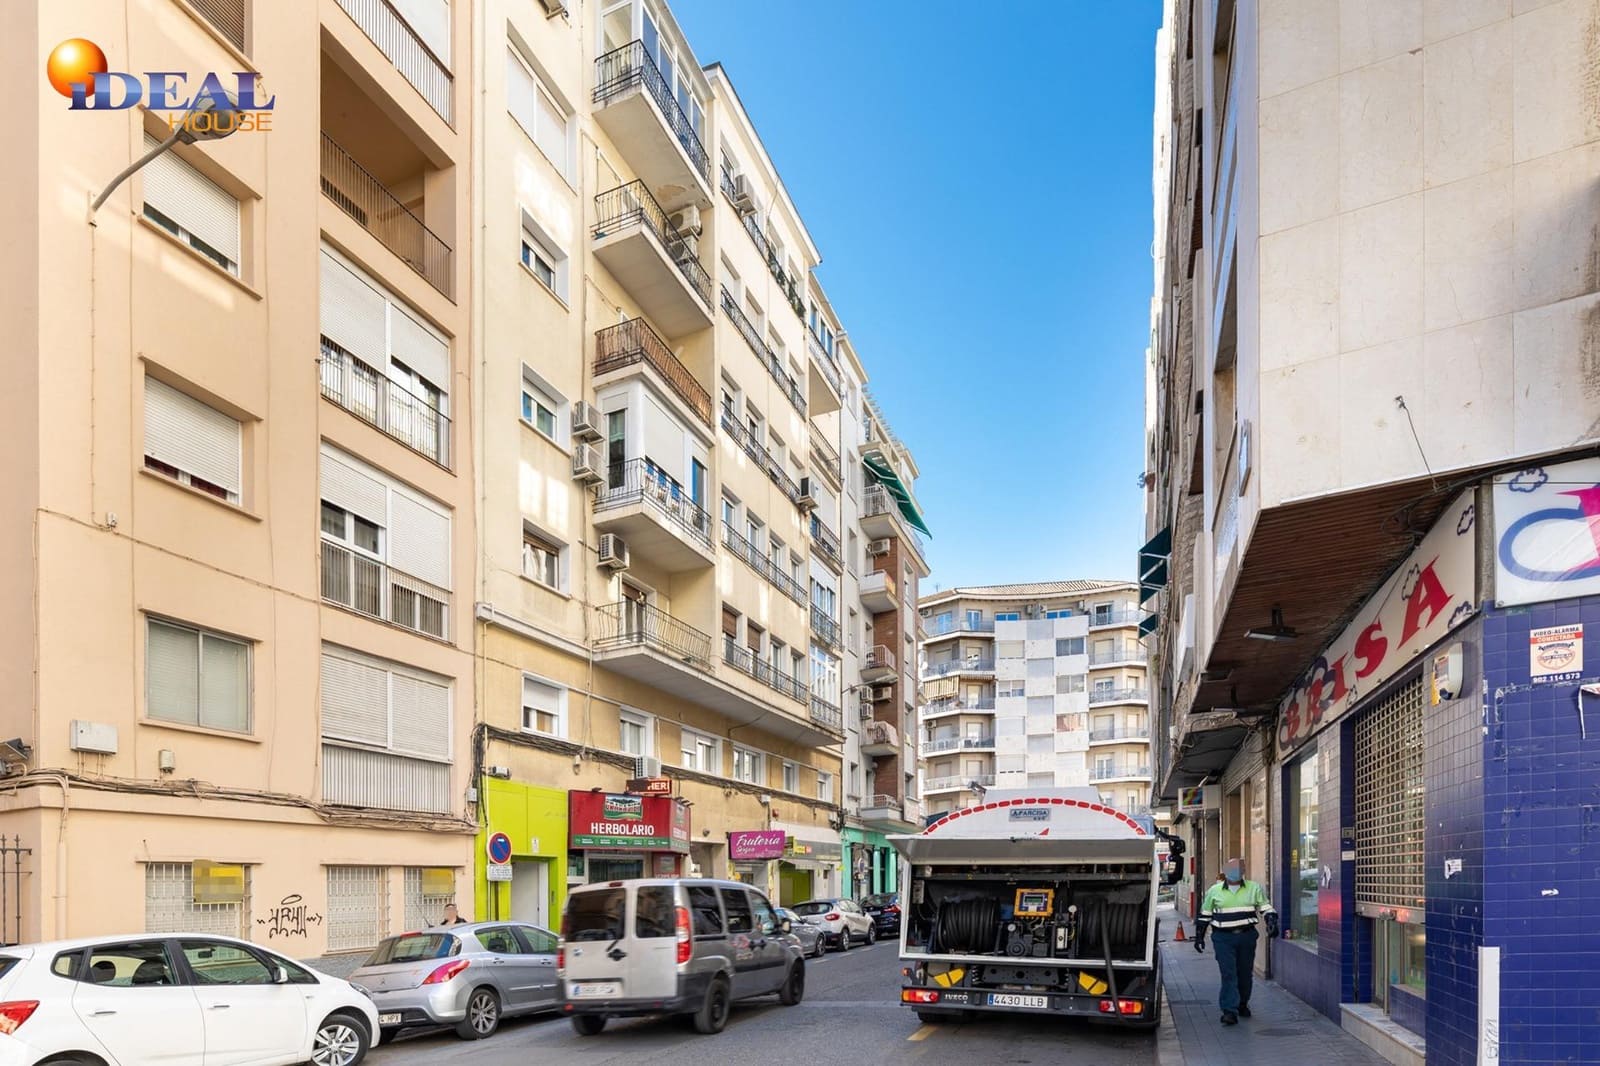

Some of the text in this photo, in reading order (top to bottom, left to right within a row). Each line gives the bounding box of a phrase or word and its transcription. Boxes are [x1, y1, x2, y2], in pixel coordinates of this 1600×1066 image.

[1533, 626, 1580, 637] VIDEO-ALARMA
[1286, 554, 1455, 741] BRISA
[1550, 674, 1564, 682] 114
[591, 822, 655, 836] HERBOLARIO
[994, 995, 1044, 1007] 4430 LLB
